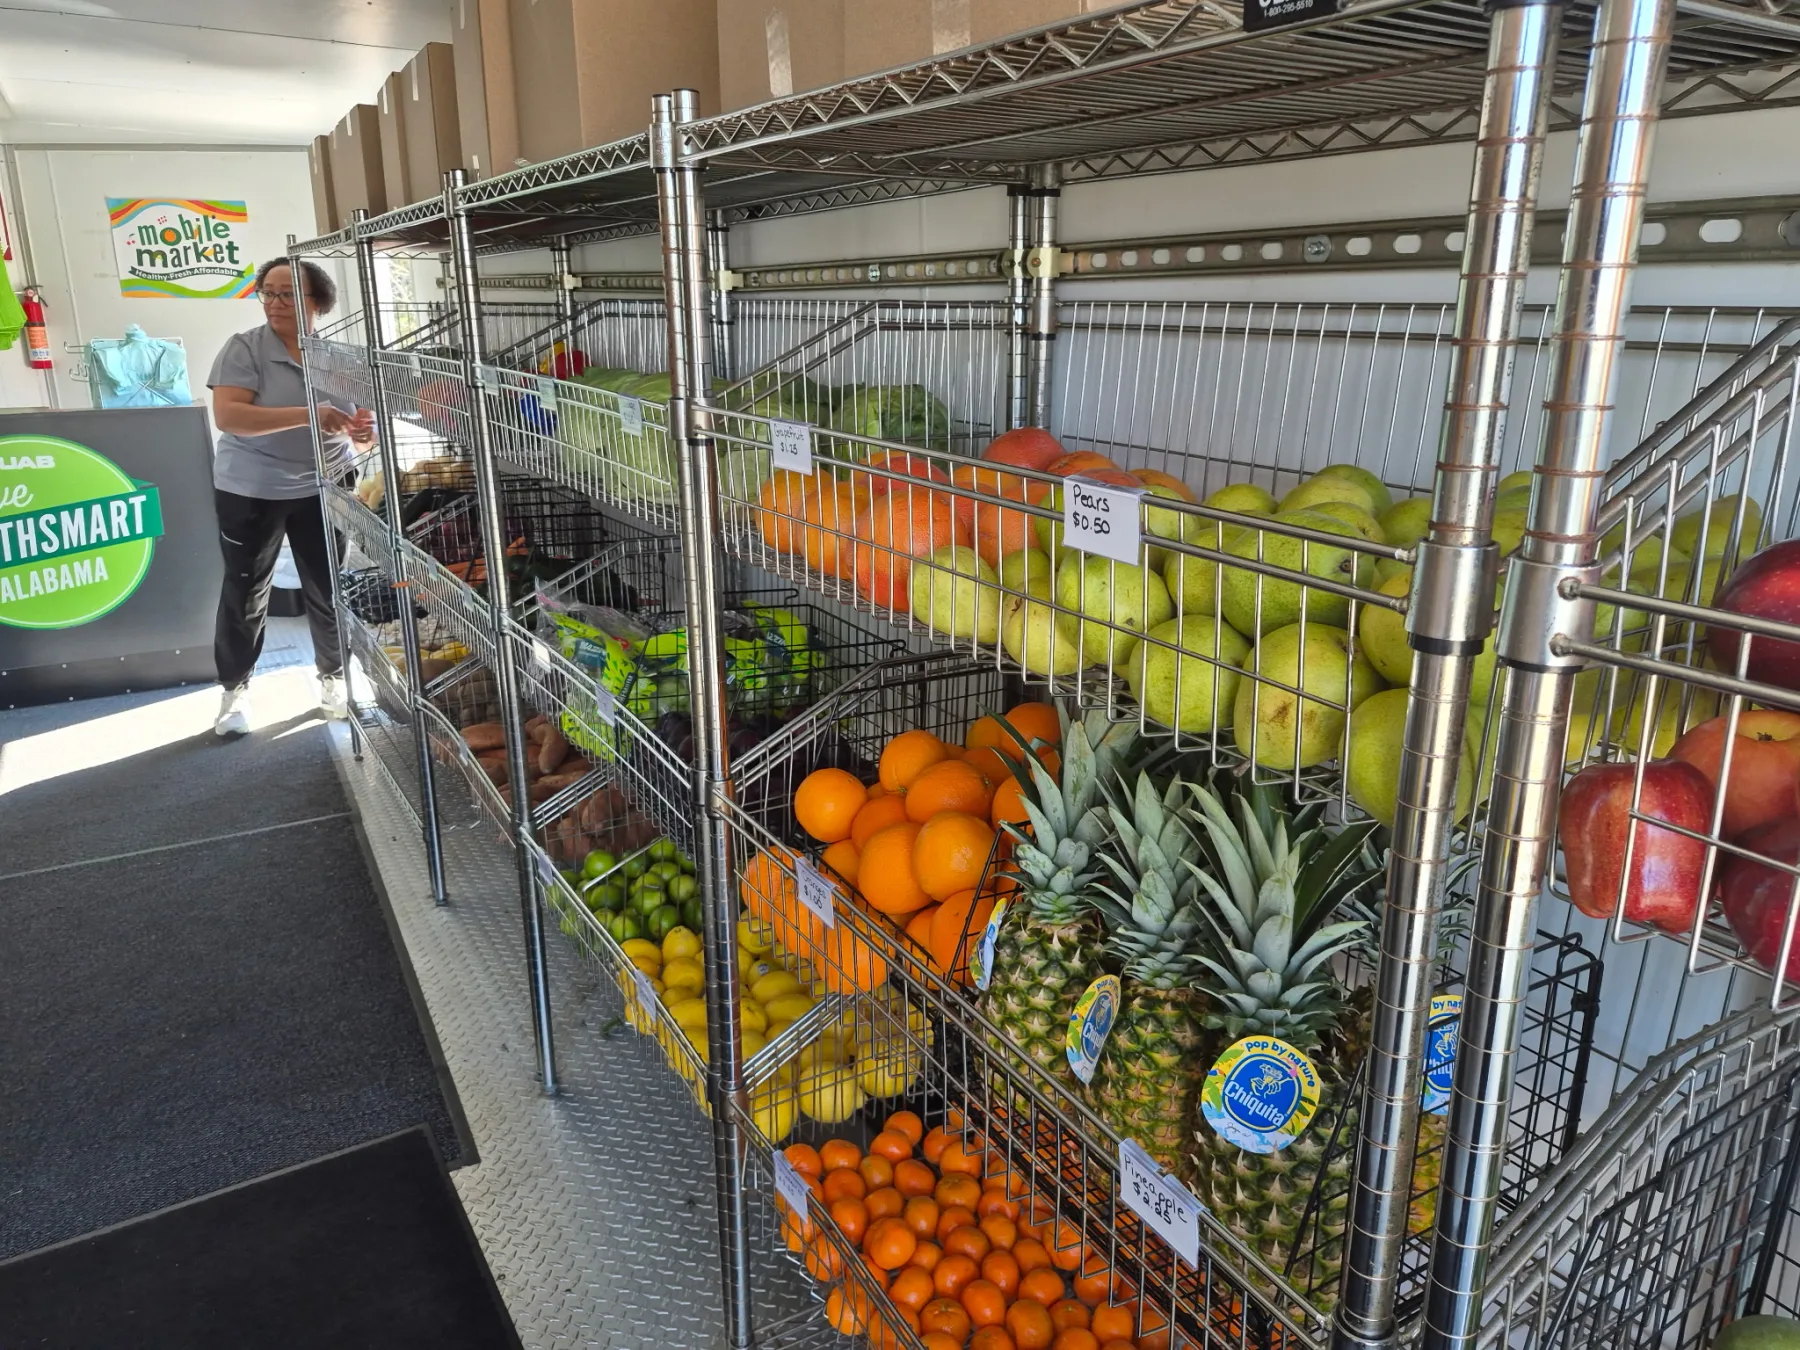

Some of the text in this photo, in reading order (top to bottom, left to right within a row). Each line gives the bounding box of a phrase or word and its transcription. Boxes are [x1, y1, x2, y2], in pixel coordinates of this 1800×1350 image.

[137, 213, 231, 247] mobile
[135, 240, 240, 268] market
[0, 455, 56, 470] UAB
[1073, 483, 1110, 512] Pears
[0, 494, 147, 562] THSMART
[1072, 510, 1111, 534] $0.50
[1, 556, 109, 603] ALABAMA
[1432, 1000, 1445, 1009] by
[1245, 1040, 1316, 1088] pop by nature
[1224, 1080, 1285, 1127] Chiquita
[1124, 1154, 1188, 1224] Pineapple
